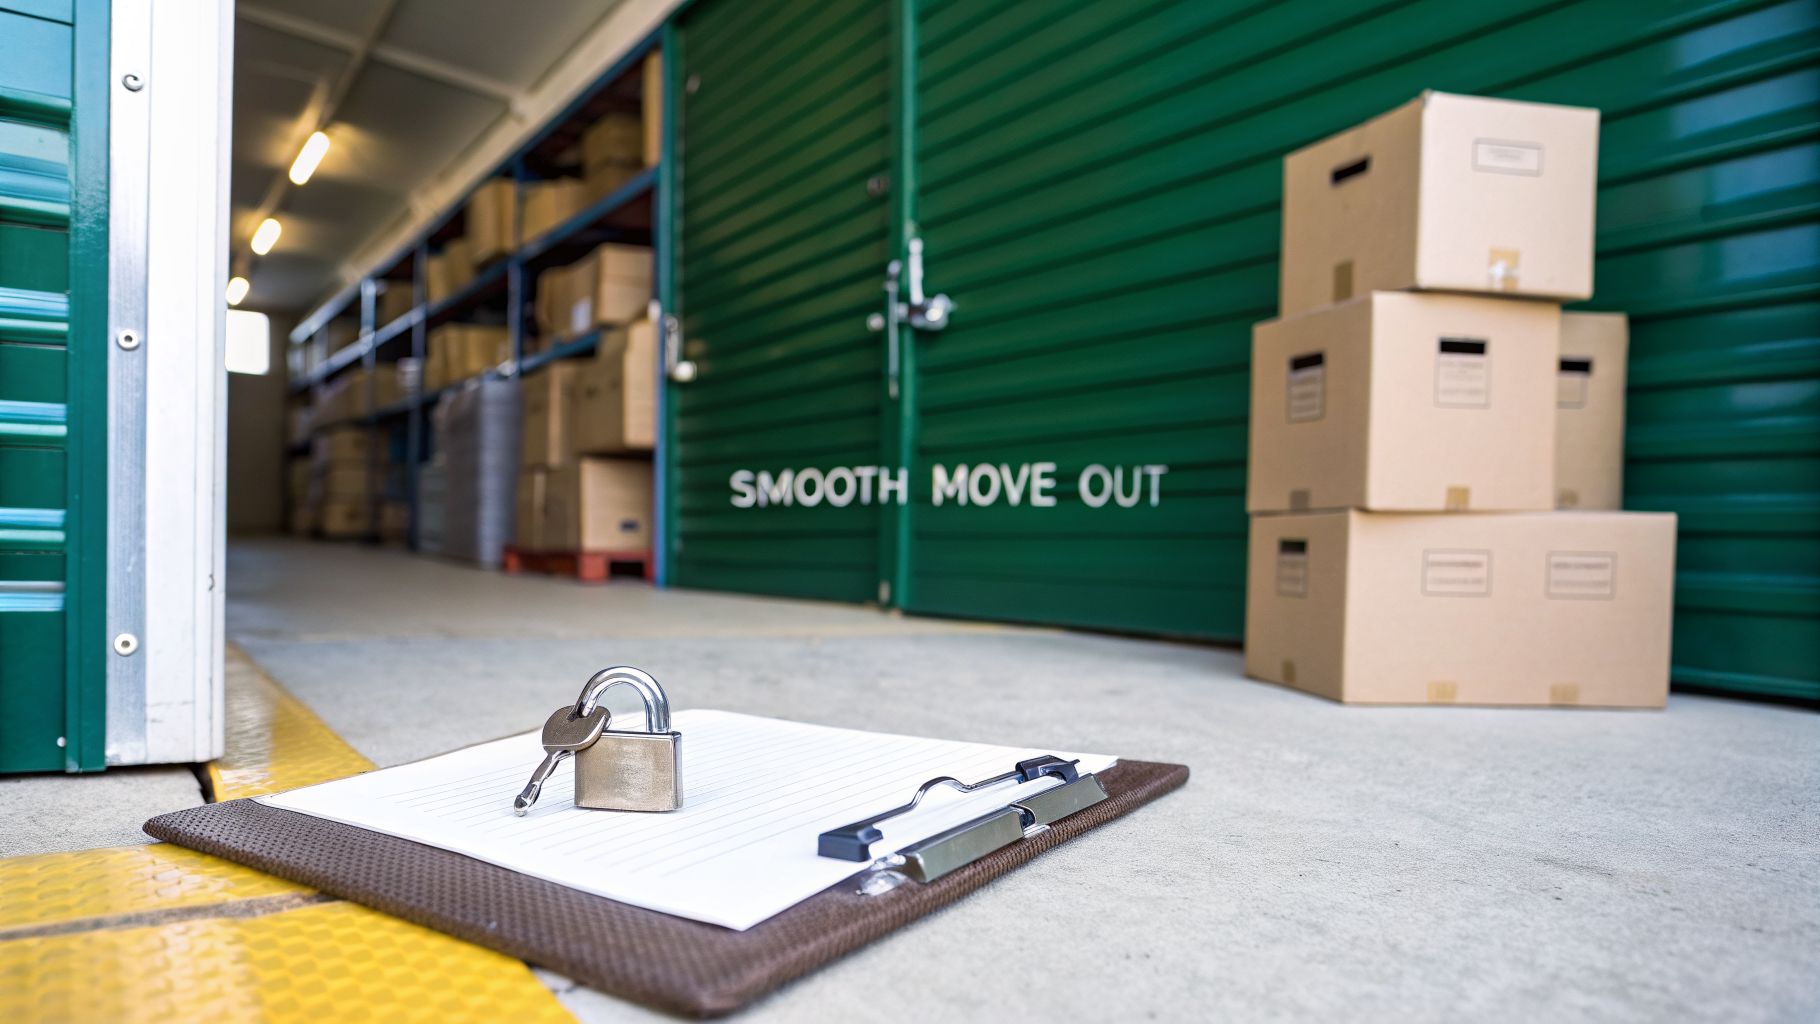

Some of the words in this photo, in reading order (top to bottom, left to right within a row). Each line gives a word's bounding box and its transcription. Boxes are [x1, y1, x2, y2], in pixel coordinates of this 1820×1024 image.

[730, 466, 908, 507] SMOOTH
[932, 462, 1057, 507] MOVE
[1078, 463, 1168, 507] OUT
